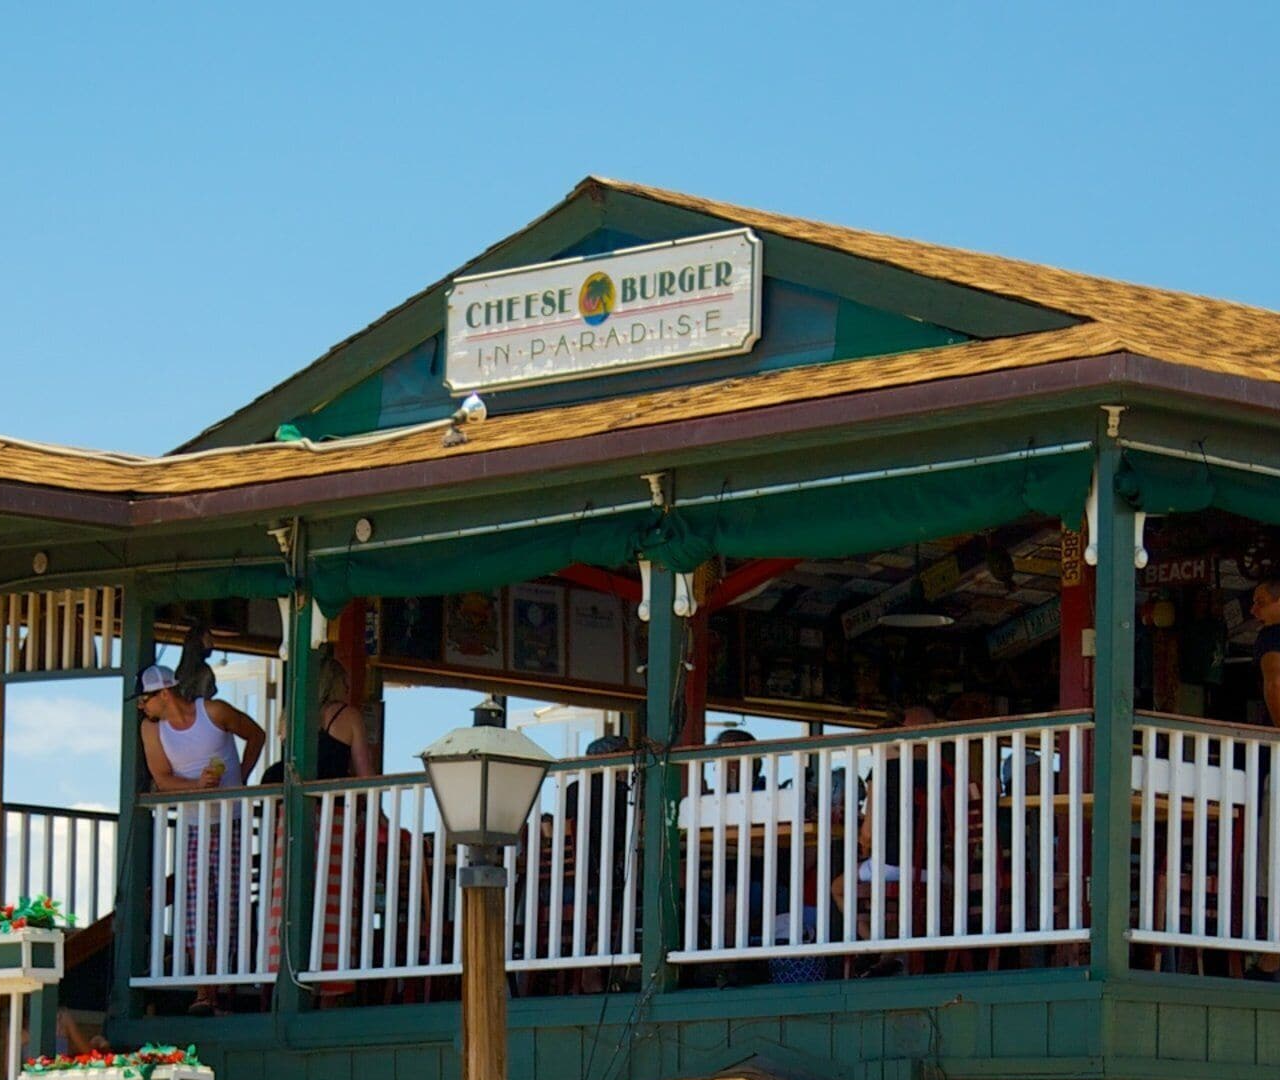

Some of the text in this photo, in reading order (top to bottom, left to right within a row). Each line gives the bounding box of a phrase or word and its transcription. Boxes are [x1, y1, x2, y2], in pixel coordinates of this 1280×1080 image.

[465, 260, 733, 329] CHEESE BURGER
[1144, 559, 1206, 584] BEACH
